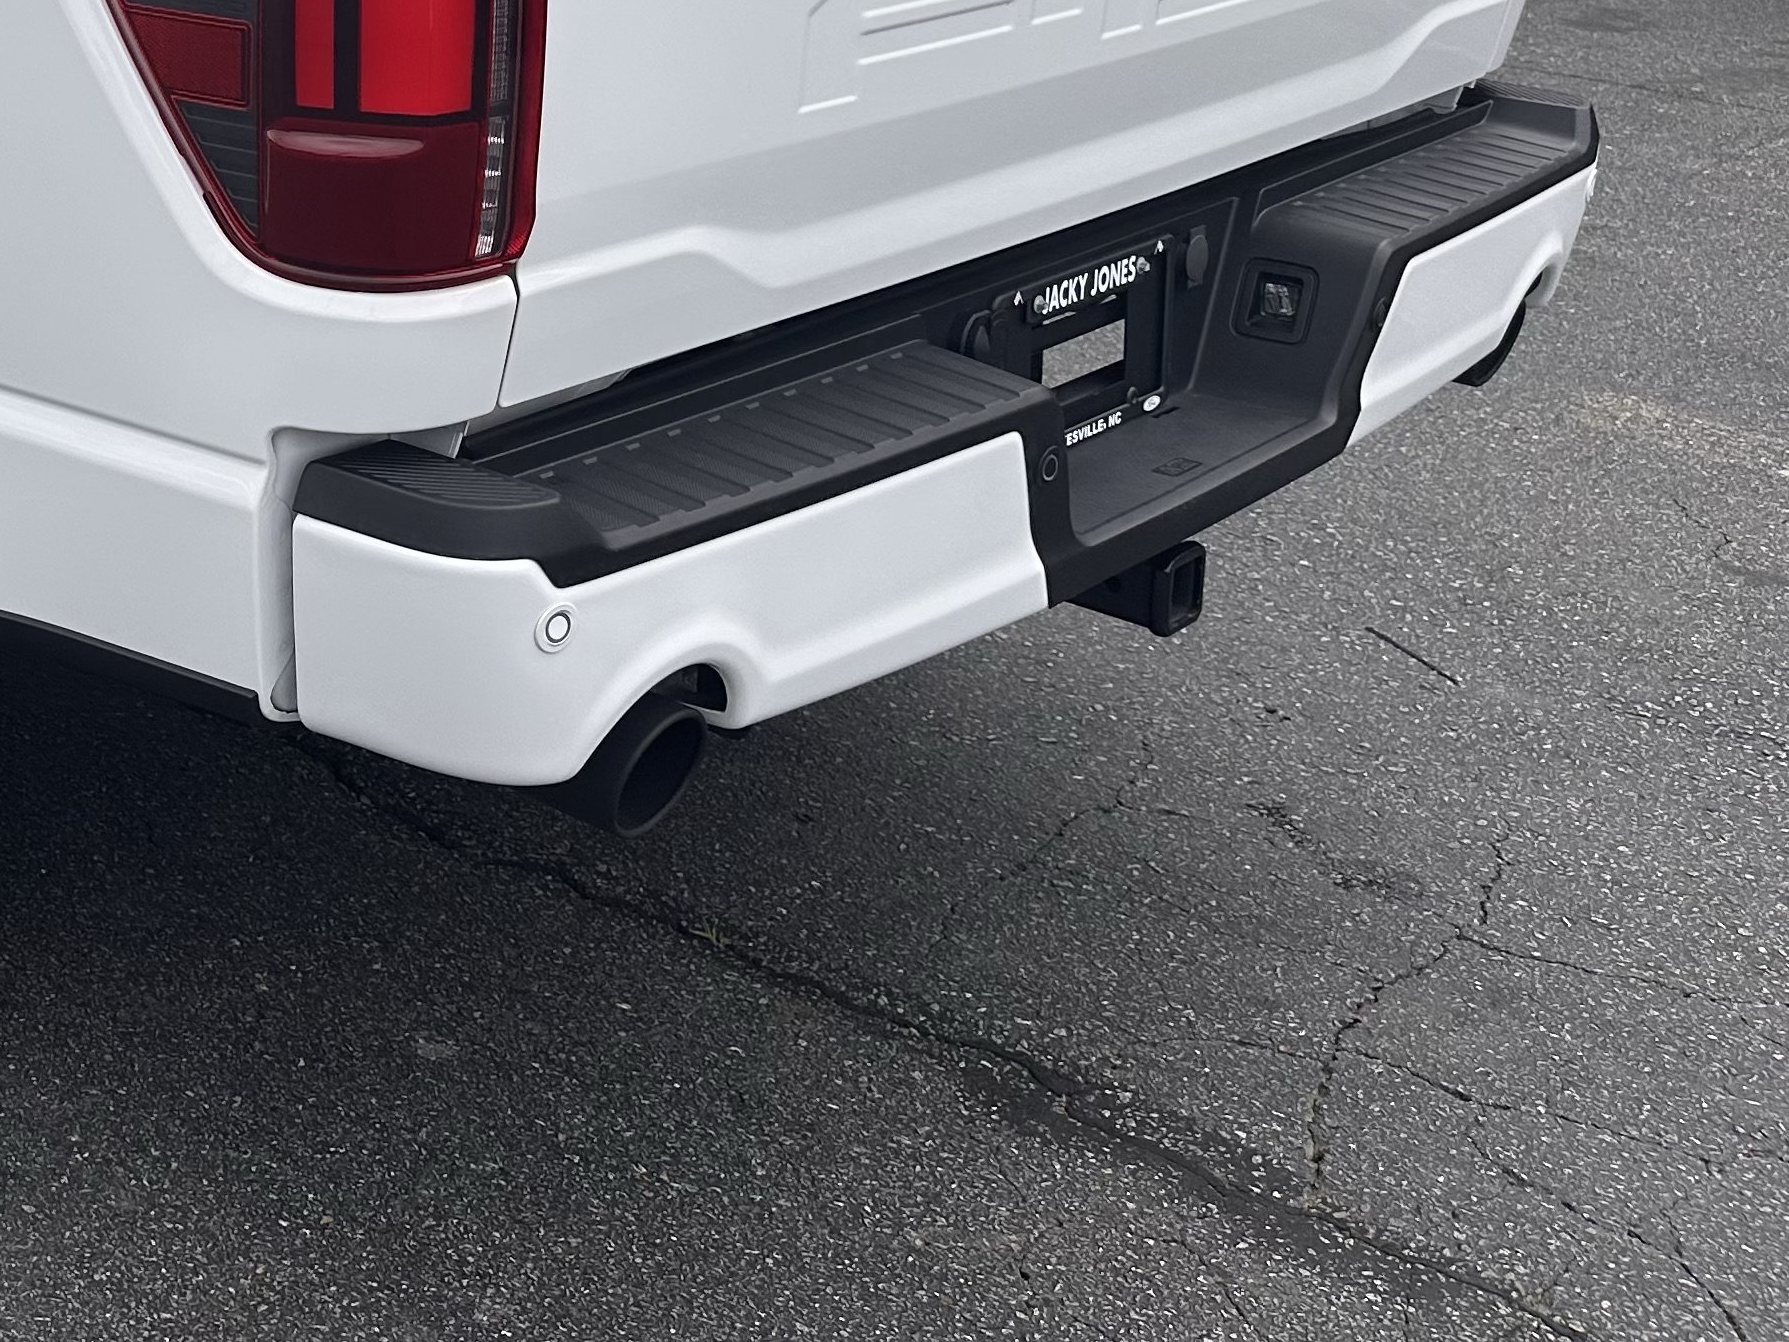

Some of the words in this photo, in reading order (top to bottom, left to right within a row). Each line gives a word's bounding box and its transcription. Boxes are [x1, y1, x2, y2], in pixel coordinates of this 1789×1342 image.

[1041, 272, 1088, 315] JACKY
[1090, 255, 1137, 297] JONES
[1107, 411, 1123, 428] NC
